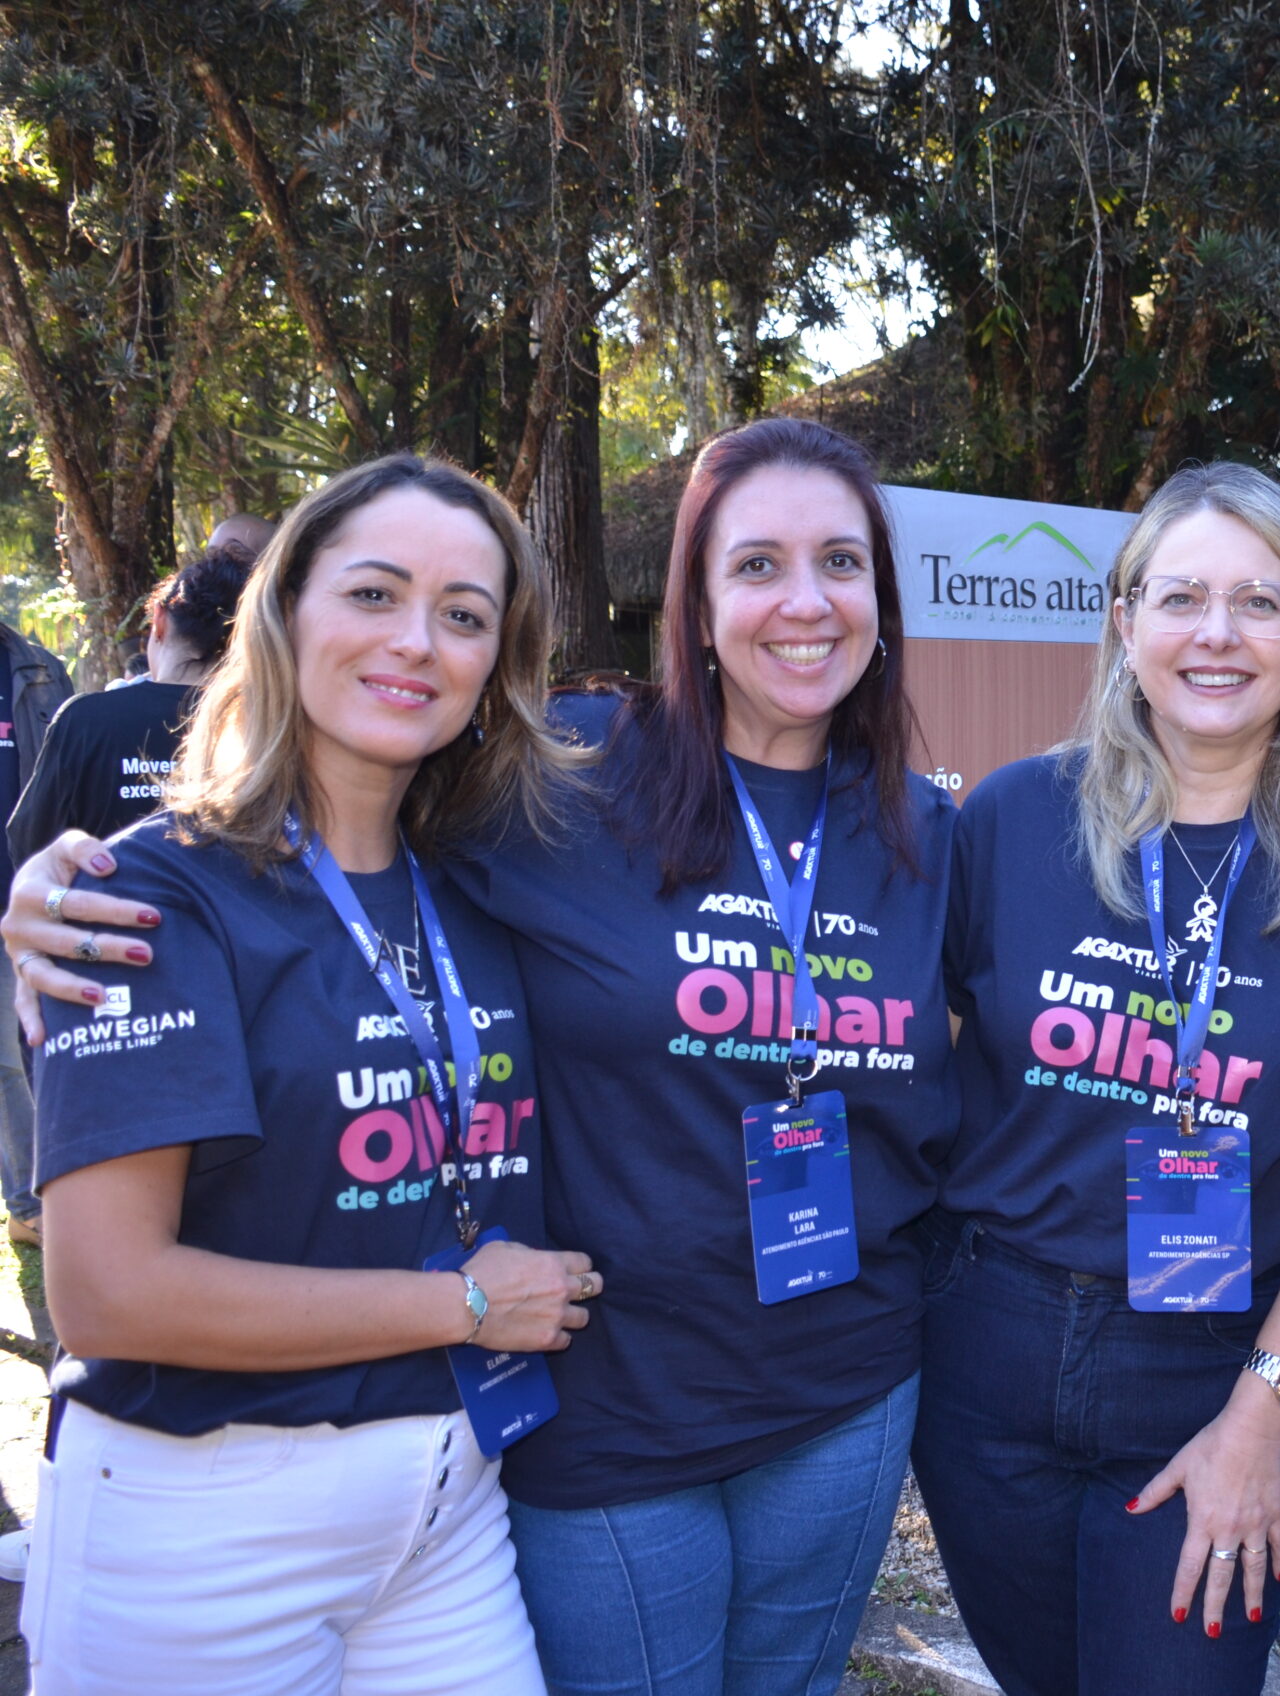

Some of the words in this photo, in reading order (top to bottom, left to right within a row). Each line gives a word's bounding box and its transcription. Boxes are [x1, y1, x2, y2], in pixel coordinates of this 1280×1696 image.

[921, 554, 1037, 609] Terras
[1046, 570, 1112, 613] alta
[122, 758, 177, 774] Mover
[746, 811, 764, 849] AGAXTUR
[762, 858, 772, 871] 70
[803, 847, 816, 880] AGAXTUR
[1152, 861, 1160, 872] 70
[1153, 878, 1162, 912] AGAXTUR
[822, 913, 855, 935] 70
[858, 922, 879, 936] anos
[675, 931, 757, 967] Um
[1040, 969, 1114, 1010] Um
[1198, 966, 1211, 1005] AGAXTUR
[1234, 975, 1263, 988] anos
[104, 992, 127, 1004] CL
[676, 968, 914, 1046] Olhar
[44, 1009, 196, 1057] NORWEGIAN
[75, 1040, 123, 1058] CRUISE
[668, 1034, 707, 1057] de
[714, 1038, 800, 1064] dentr
[816, 1048, 860, 1071] pra
[866, 1047, 914, 1071] fora
[1030, 1006, 1263, 1104] Olhar
[337, 1067, 413, 1109] Um
[1024, 1066, 1057, 1086] de
[1063, 1071, 1148, 1105] dentro
[1198, 1101, 1249, 1130] fora
[772, 1122, 790, 1133] Um
[791, 1118, 815, 1129] novo
[774, 1128, 823, 1150] Olhar
[1159, 1148, 1178, 1157] Um
[1180, 1150, 1209, 1158] novo
[1159, 1157, 1219, 1174] Olhar
[337, 1186, 379, 1210] de
[788, 1206, 819, 1223] KARINA
[794, 1220, 816, 1235] LARA
[1161, 1234, 1182, 1245] ELIS
[1183, 1235, 1217, 1245] ZONATI
[762, 1240, 797, 1255] ATENDIMENTO
[832, 1226, 849, 1237] PAULO
[1148, 1251, 1190, 1259] ATENDIMENTO
